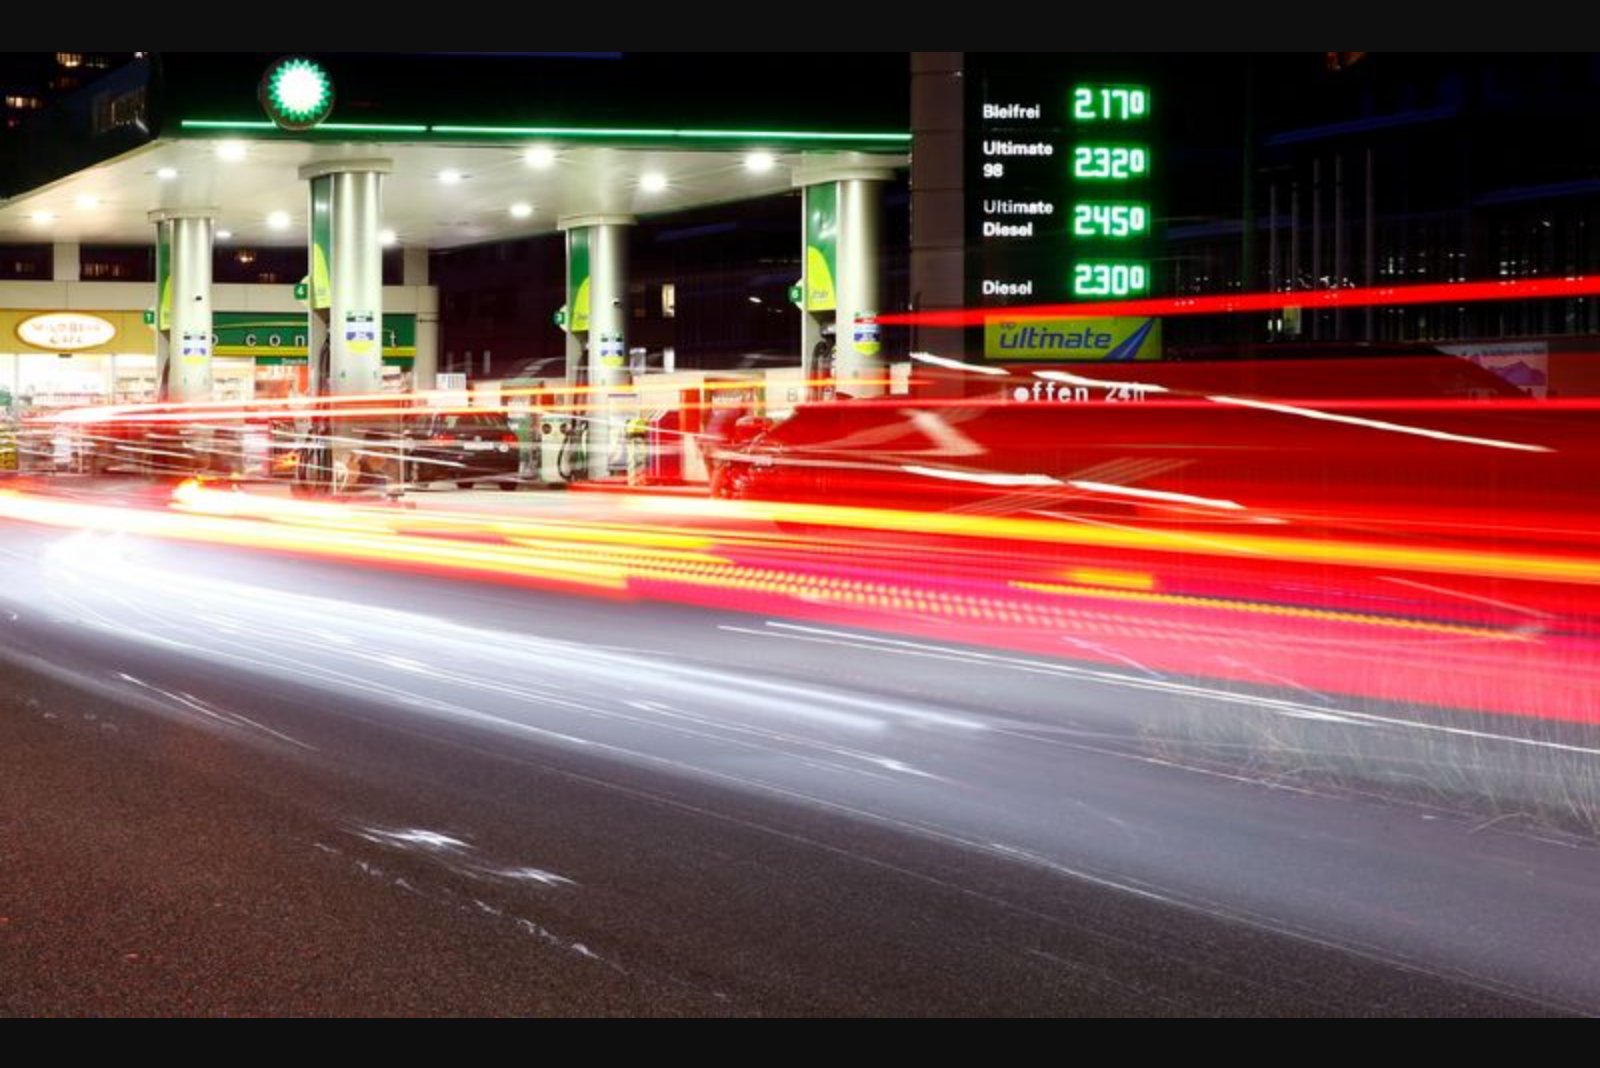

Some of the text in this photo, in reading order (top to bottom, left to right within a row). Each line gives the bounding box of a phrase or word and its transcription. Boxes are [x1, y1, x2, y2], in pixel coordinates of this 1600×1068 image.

[983, 103, 1041, 119] Bleifrei
[983, 140, 1053, 156] Ultimate
[983, 162, 1004, 178] 98
[983, 199, 1054, 215] Ultimate
[982, 221, 1034, 237] Diesel
[982, 279, 1034, 295] Diesel
[1000, 327, 1112, 349] ultimate
[1014, 381, 1089, 403] offen
